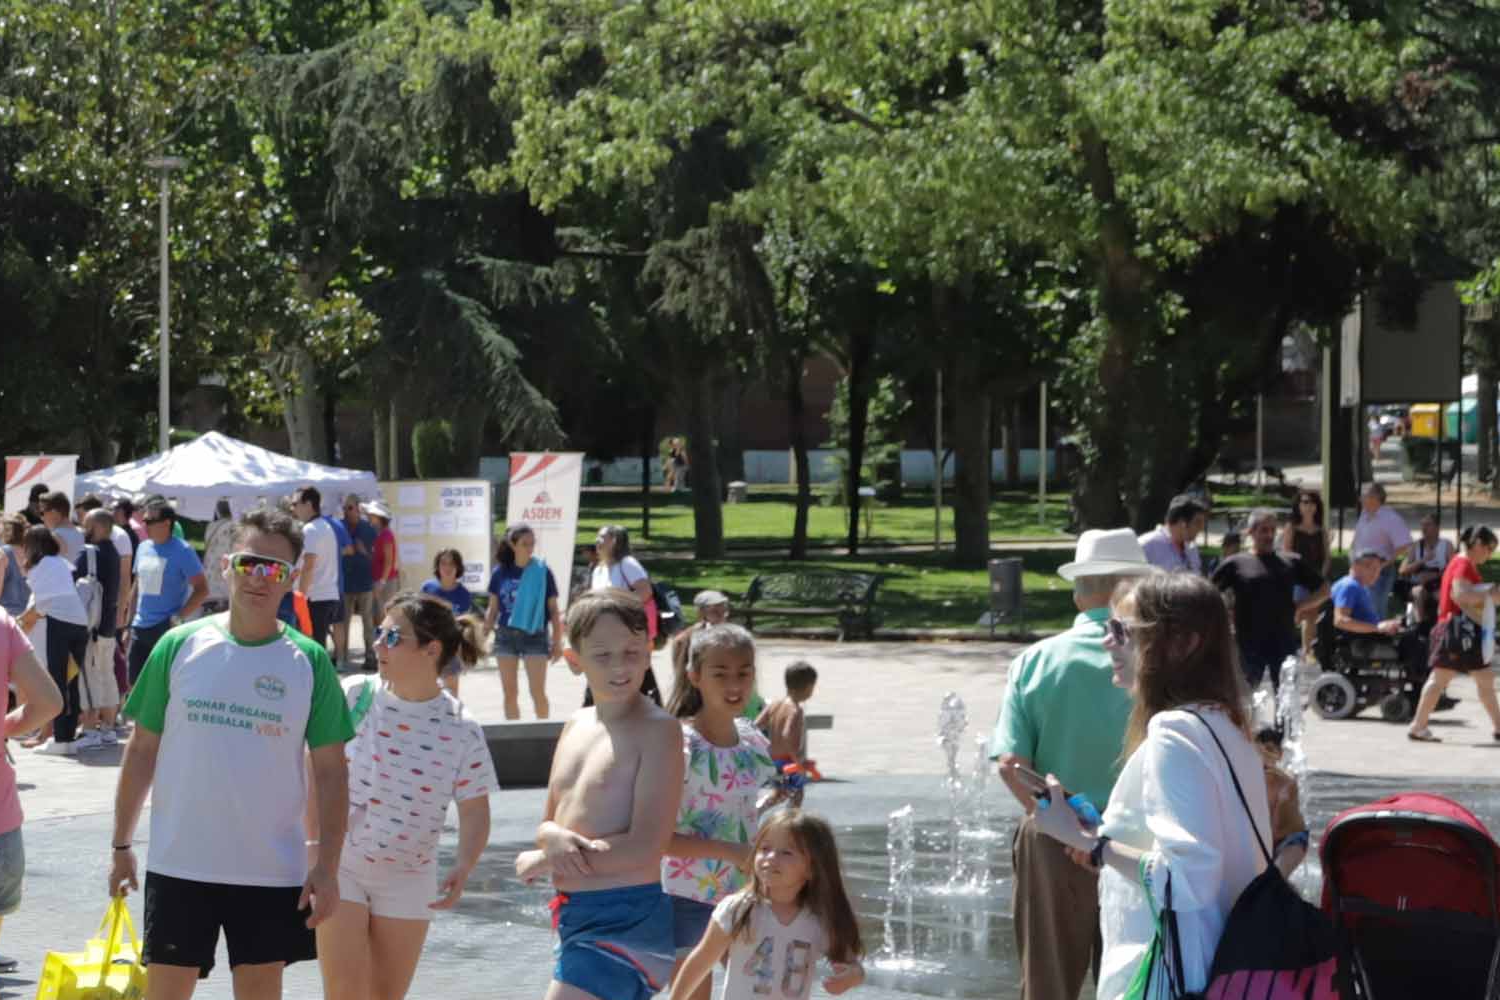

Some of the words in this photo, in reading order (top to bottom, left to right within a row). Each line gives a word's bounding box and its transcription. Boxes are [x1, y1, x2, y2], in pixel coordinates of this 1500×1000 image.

[522, 507, 563, 519] ASDEM
[202, 713, 253, 730] REGALAR
[742, 936, 813, 1000] 48
